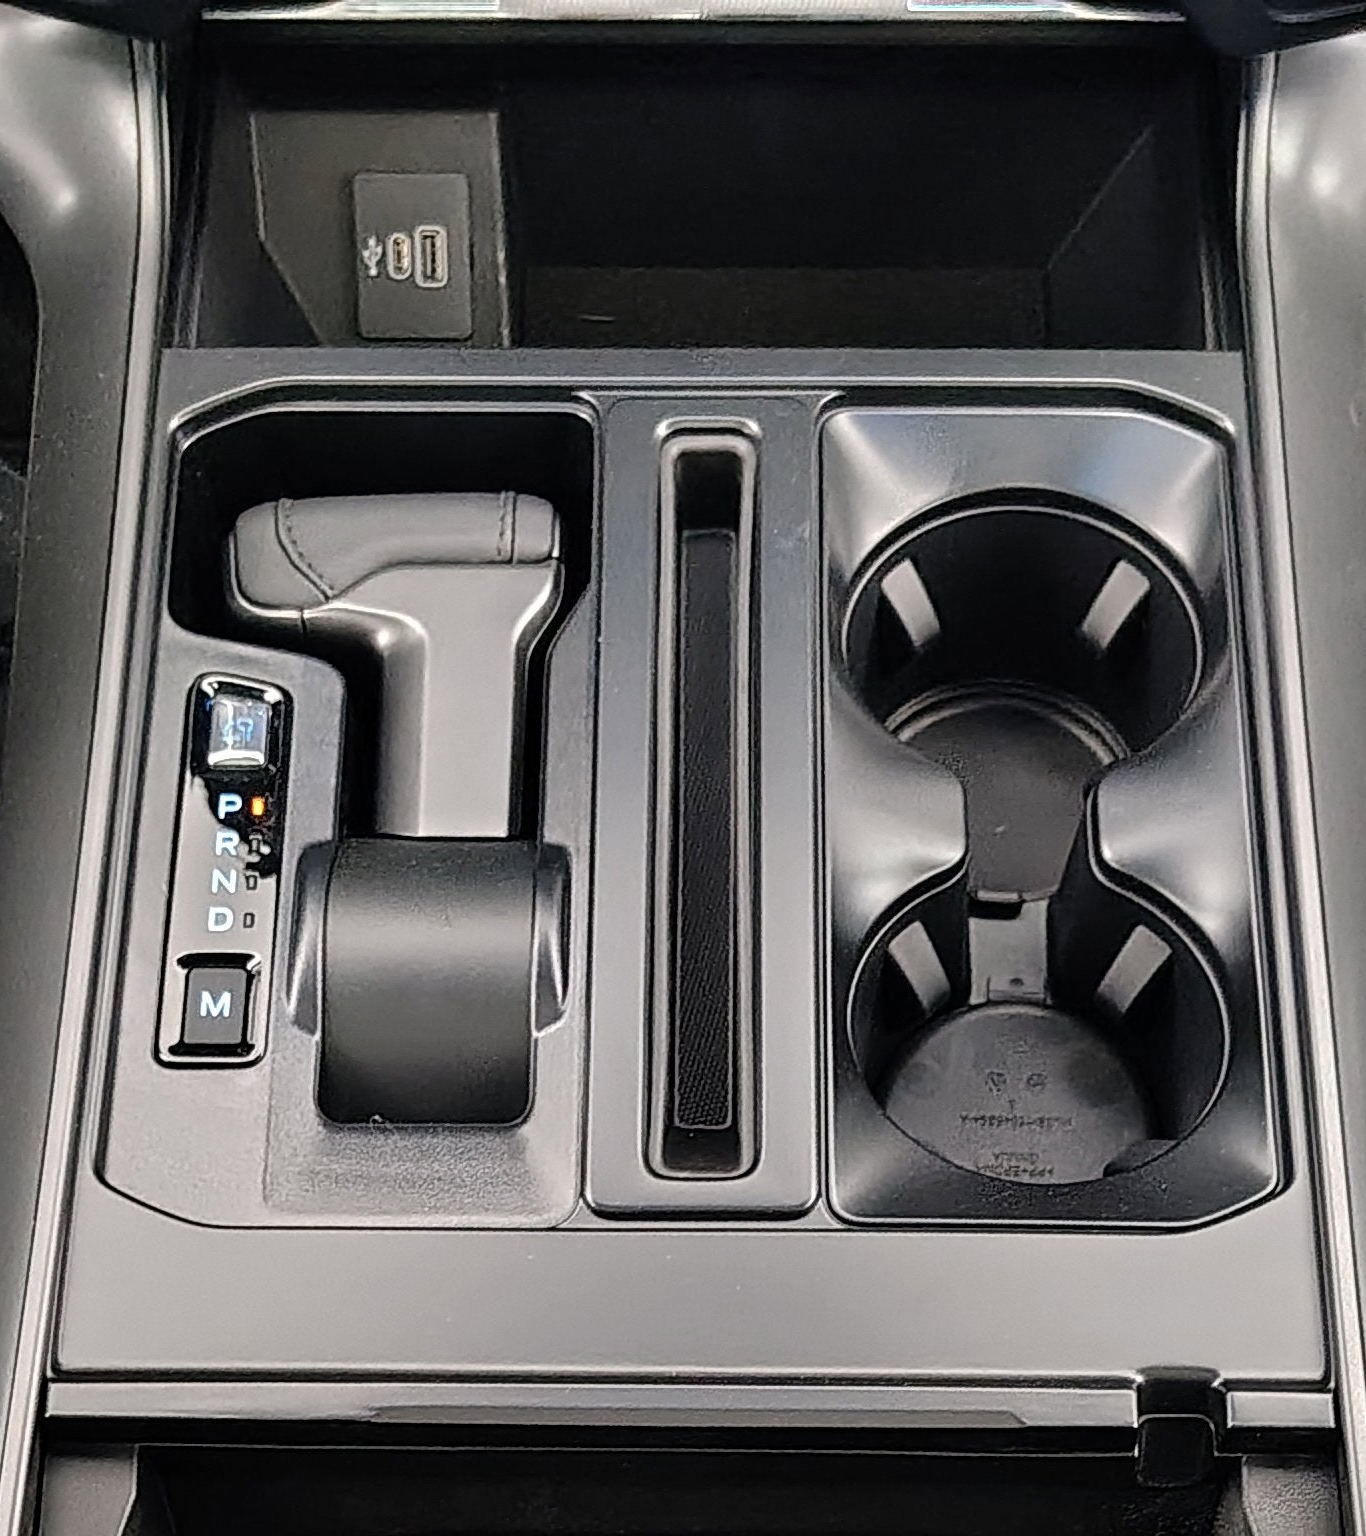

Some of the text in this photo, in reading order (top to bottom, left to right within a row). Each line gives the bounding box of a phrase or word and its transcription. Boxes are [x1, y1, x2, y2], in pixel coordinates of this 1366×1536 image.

[217, 793, 243, 820] P
[214, 829, 240, 856] R
[211, 869, 237, 894] N
[208, 906, 234, 932] D
[199, 991, 232, 1018] M
